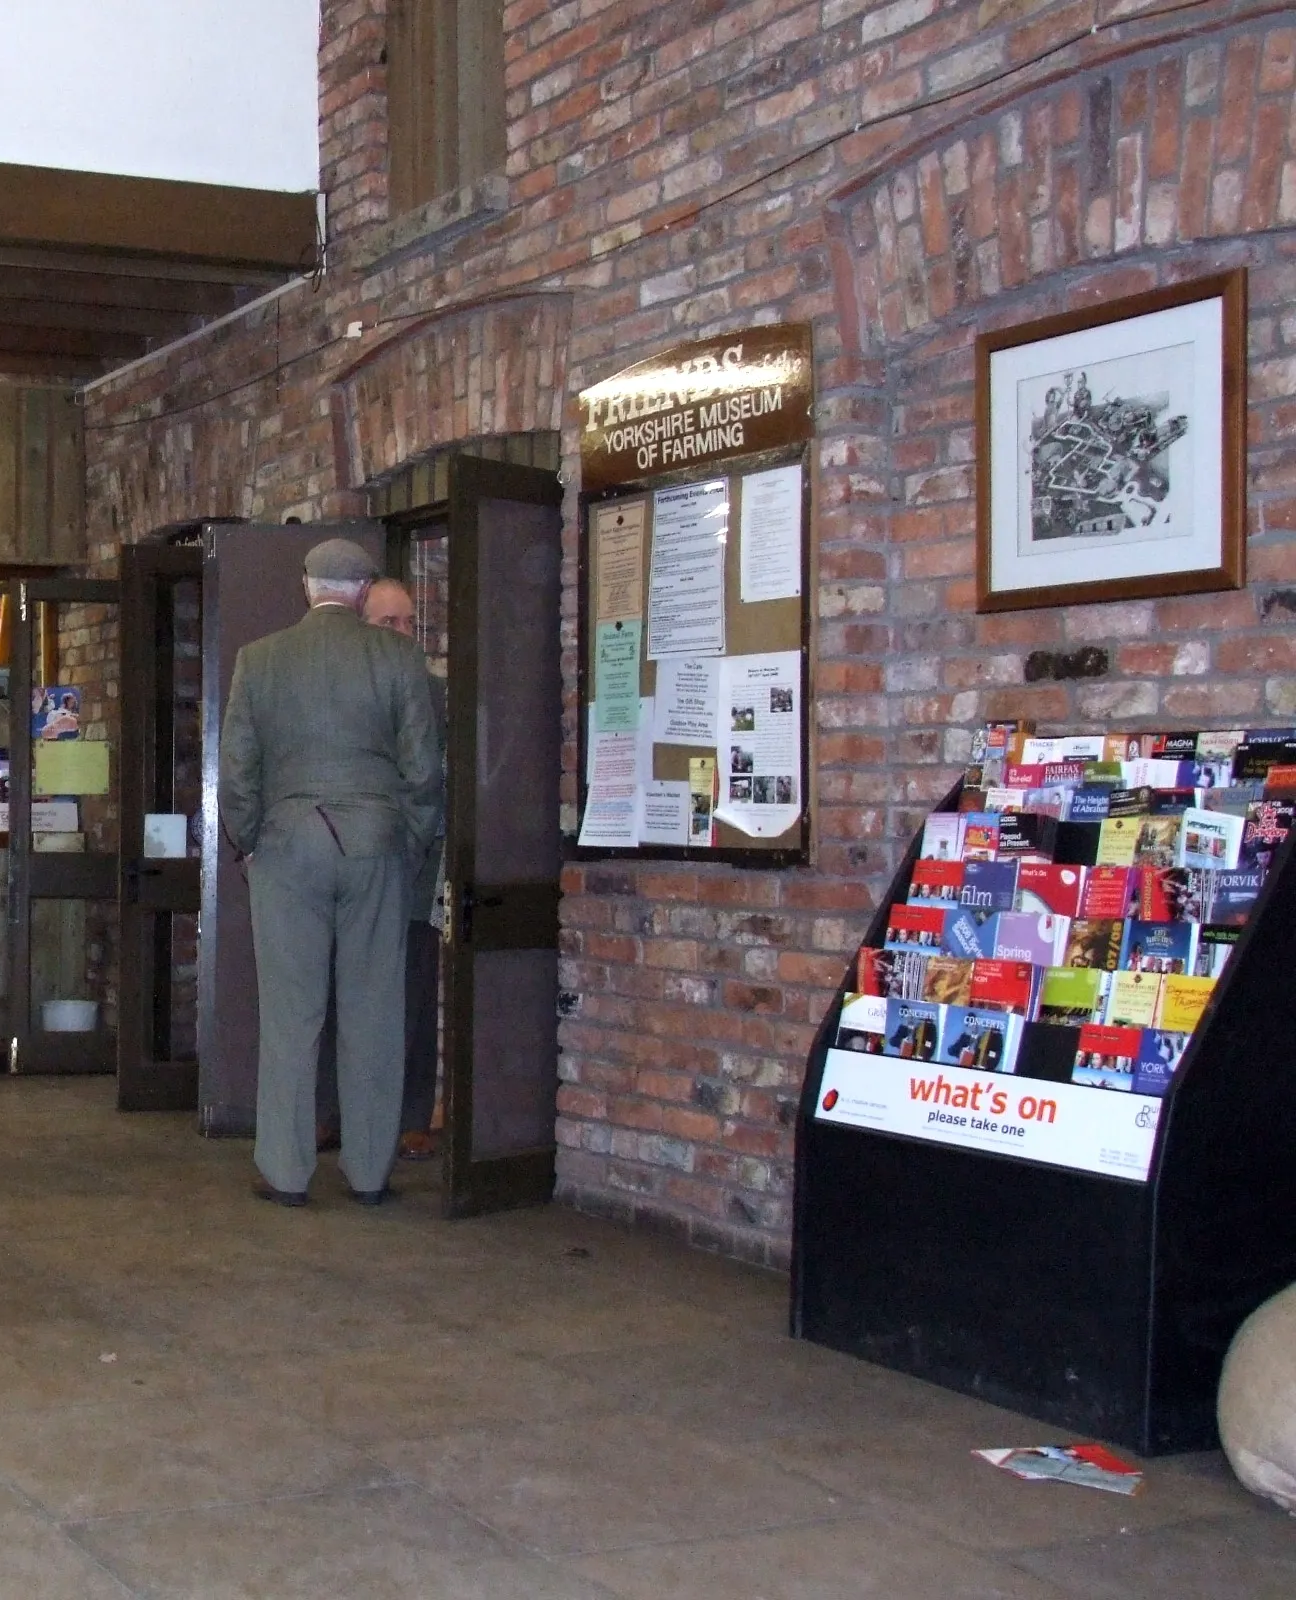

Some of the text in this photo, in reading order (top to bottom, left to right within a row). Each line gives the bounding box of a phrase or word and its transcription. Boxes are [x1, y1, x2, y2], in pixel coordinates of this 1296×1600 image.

[604, 386, 782, 454] YORKSHIRE MUSEUM
[637, 423, 744, 469] OF FARMING
[1166, 739, 1193, 748] MAGNA
[1045, 764, 1079, 774] FAIRFAX
[1074, 796, 1085, 804] The
[1021, 868, 1037, 877] What's
[1220, 875, 1259, 888] JORVIK
[961, 884, 993, 906] film
[996, 944, 1033, 961] Spring
[1106, 921, 1123, 969] 07/08
[898, 1006, 937, 1020] CONCERTS
[963, 1015, 1005, 1030] CONCERTS
[1141, 1061, 1165, 1074] YORK
[909, 1074, 1009, 1114] what's
[1018, 1095, 1057, 1124] on
[927, 1110, 967, 1127] please
[970, 1116, 998, 1132] take
[1001, 1123, 1025, 1137] one
